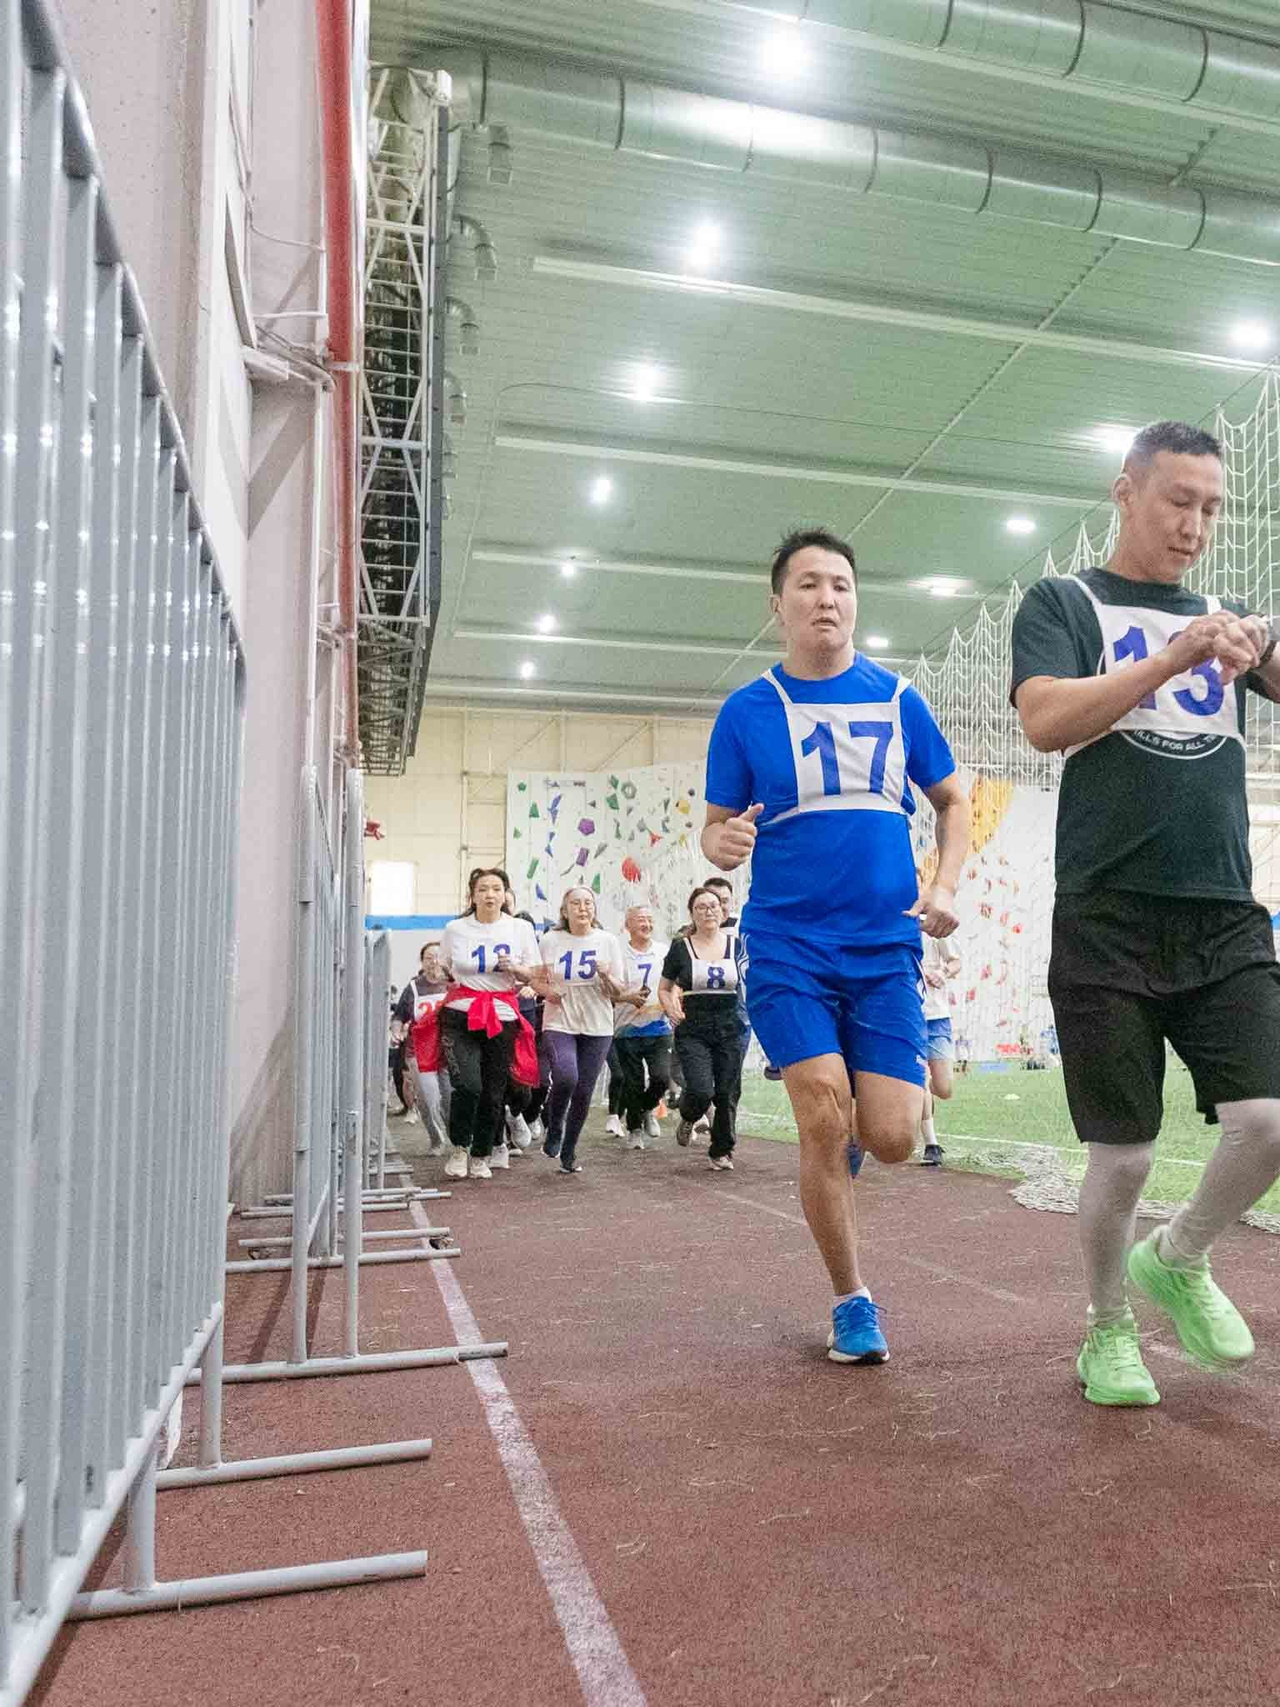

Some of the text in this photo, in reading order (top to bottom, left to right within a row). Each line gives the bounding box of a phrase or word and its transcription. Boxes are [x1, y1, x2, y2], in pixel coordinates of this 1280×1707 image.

[801, 720, 895, 796] 17
[1162, 740, 1184, 752] FOR
[559, 950, 597, 981] 15
[638, 963, 652, 992] 7
[707, 966, 726, 990] 8
